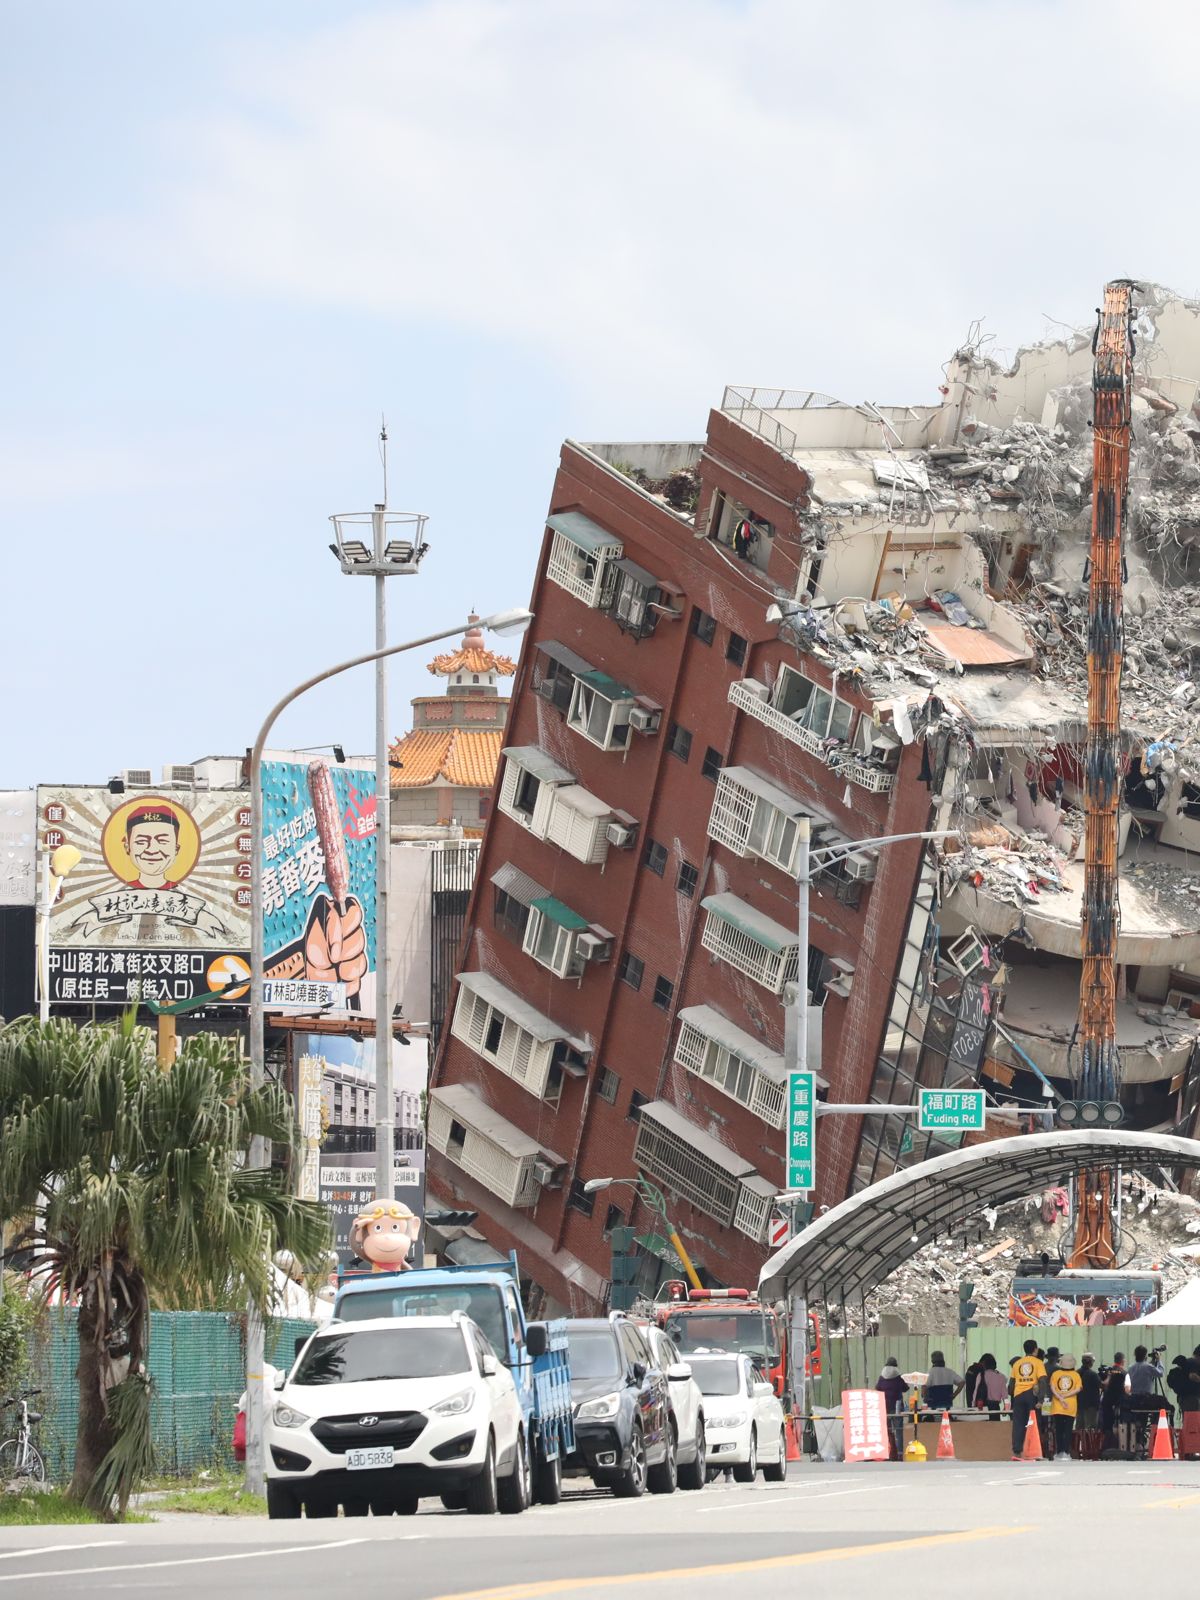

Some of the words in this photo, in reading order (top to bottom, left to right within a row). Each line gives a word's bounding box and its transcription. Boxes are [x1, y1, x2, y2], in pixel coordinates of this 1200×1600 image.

[263, 807, 317, 861] 最好吃的
[49, 952, 204, 974] 中山路北濱街交叉路口
[274, 982, 328, 1002] 林記燒番麥
[928, 1094, 977, 1111] 福町路
[793, 1089, 809, 1147] 重慶路
[927, 1114, 959, 1125] Fuding
[962, 1115, 977, 1124] Rd.
